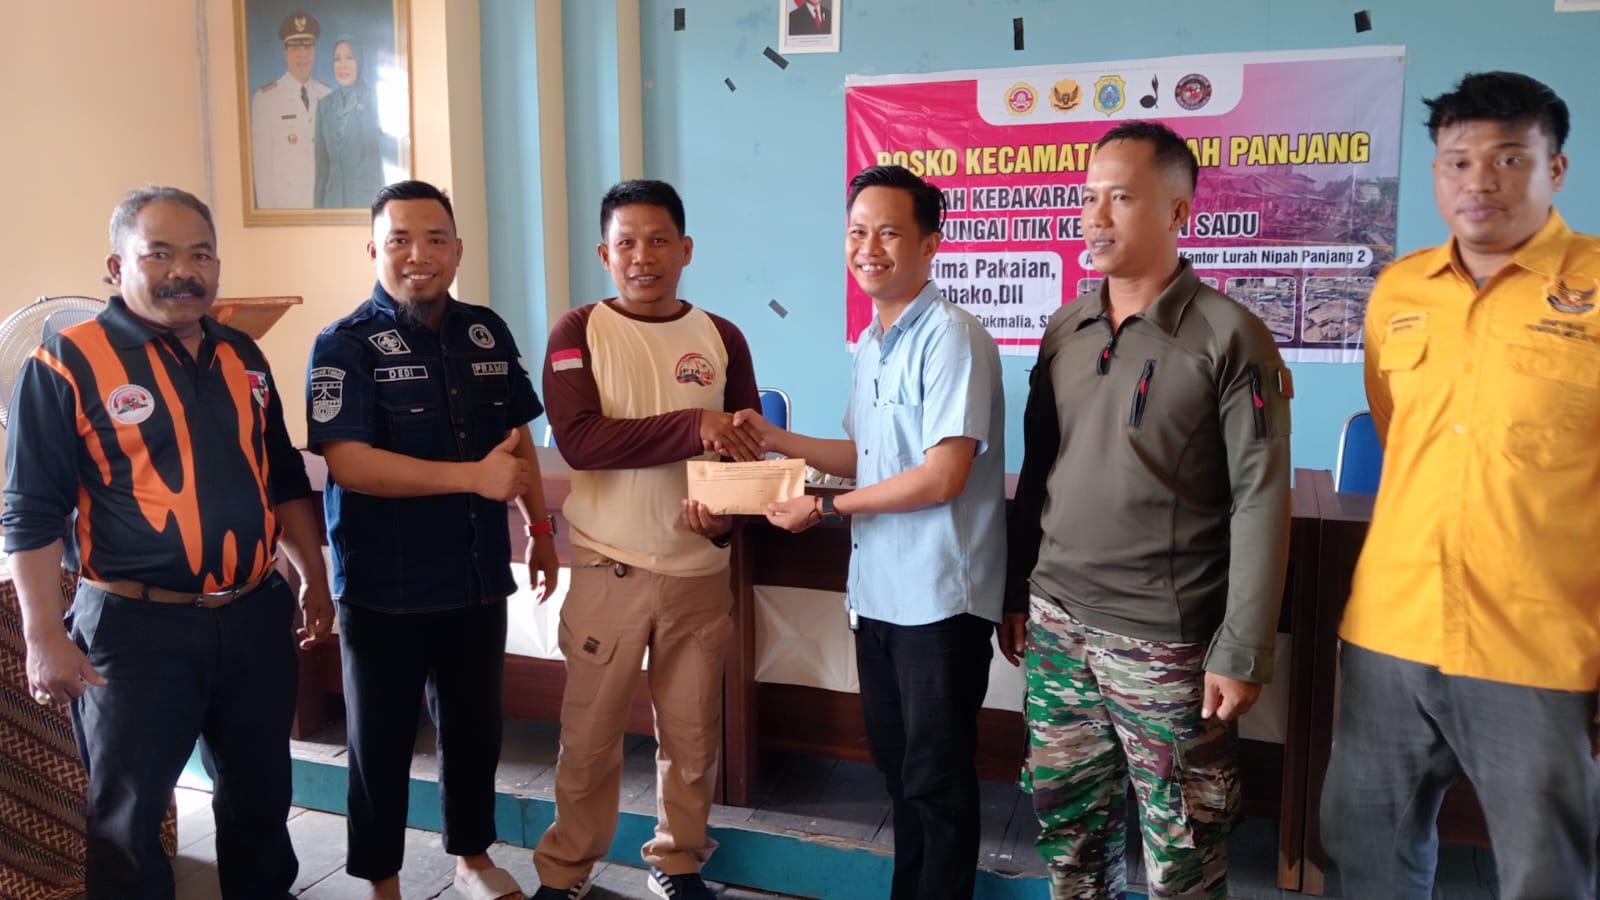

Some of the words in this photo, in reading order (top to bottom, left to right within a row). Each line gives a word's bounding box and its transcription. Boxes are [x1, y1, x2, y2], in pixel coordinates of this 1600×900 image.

[1229, 132, 1370, 166] PANJANG
[1013, 217, 1051, 240] ITIK
[1196, 213, 1258, 237] SADU
[975, 258, 1056, 281] Pakaian,
[1222, 251, 1257, 264] Lurah
[1261, 251, 1298, 266] Nipah
[1302, 250, 1353, 266] Panjang
[1357, 250, 1366, 263] 2
